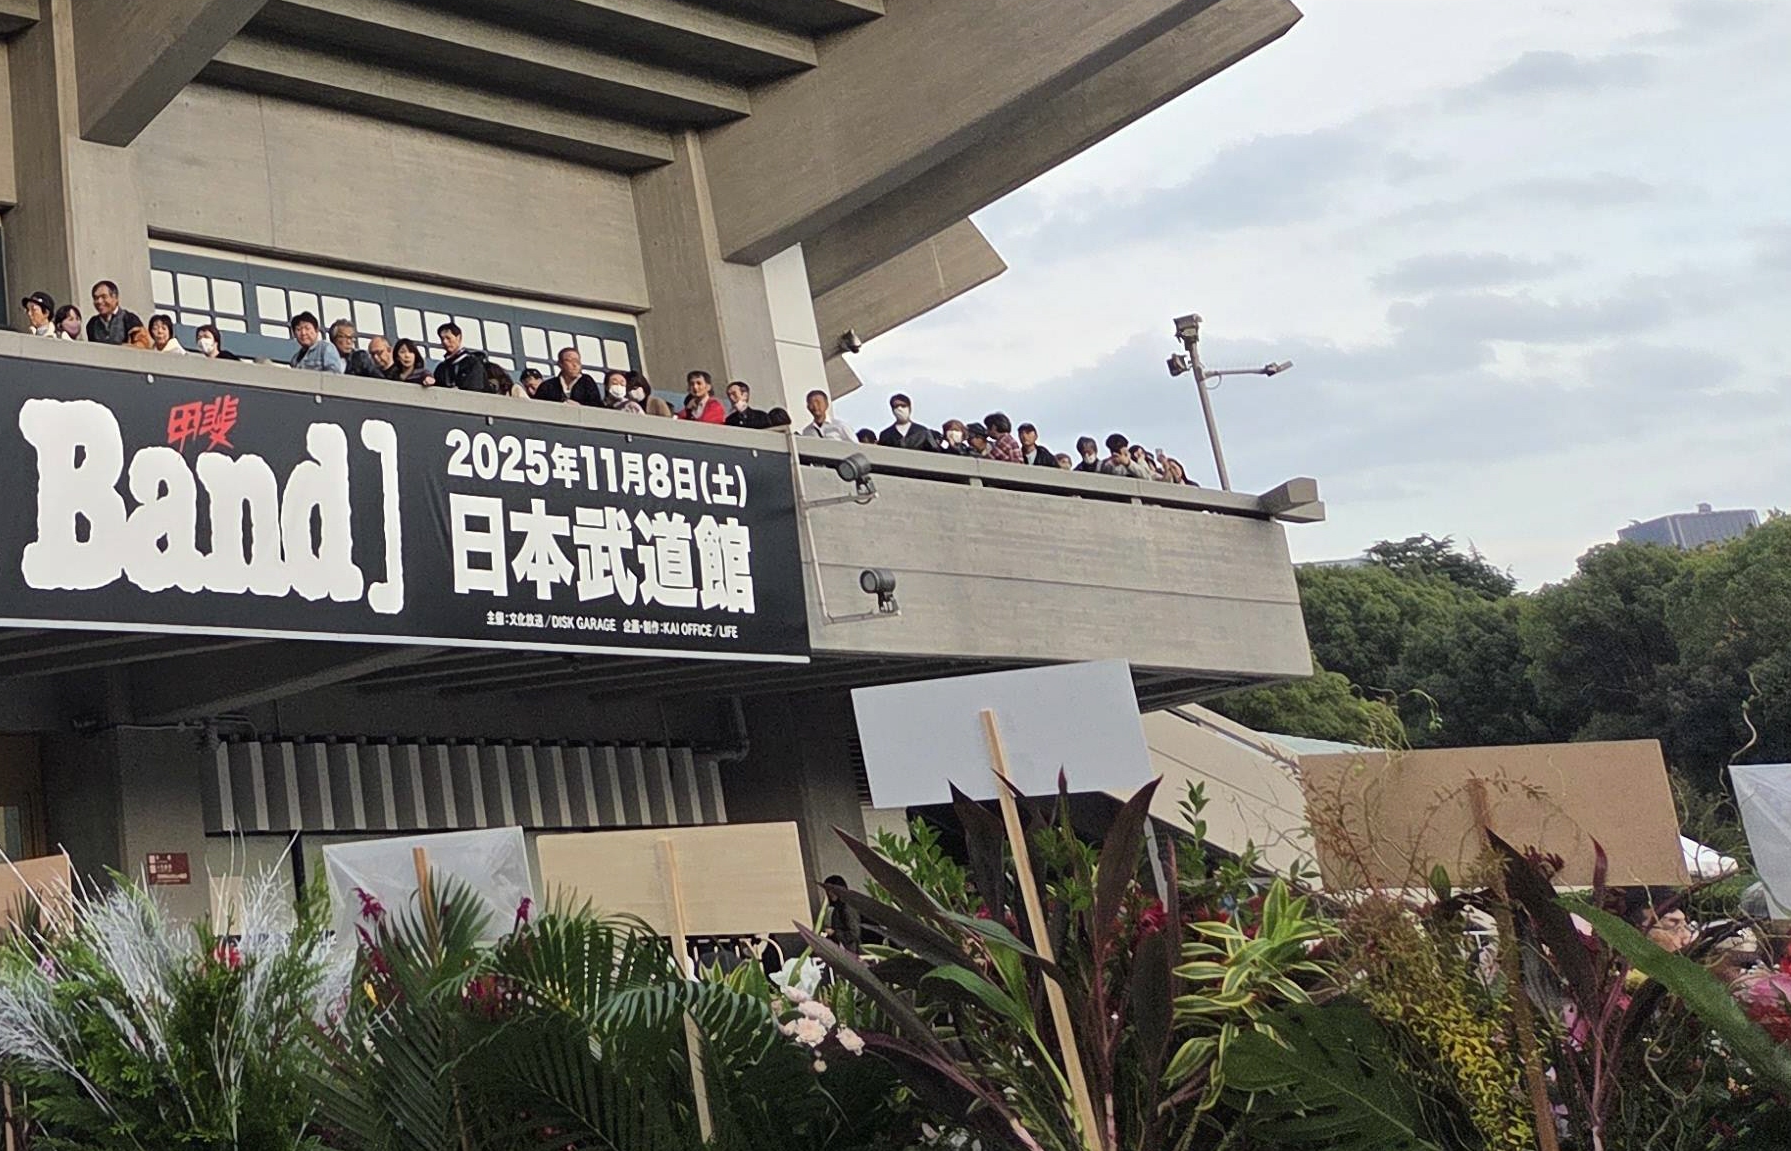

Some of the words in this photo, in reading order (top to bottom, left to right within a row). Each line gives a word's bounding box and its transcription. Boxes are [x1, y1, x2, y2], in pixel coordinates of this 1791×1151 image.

[445, 428, 747, 508] 2025年11月8日(土)
[449, 492, 756, 614] 日本武道館
[576, 616, 617, 632] GARAGE
